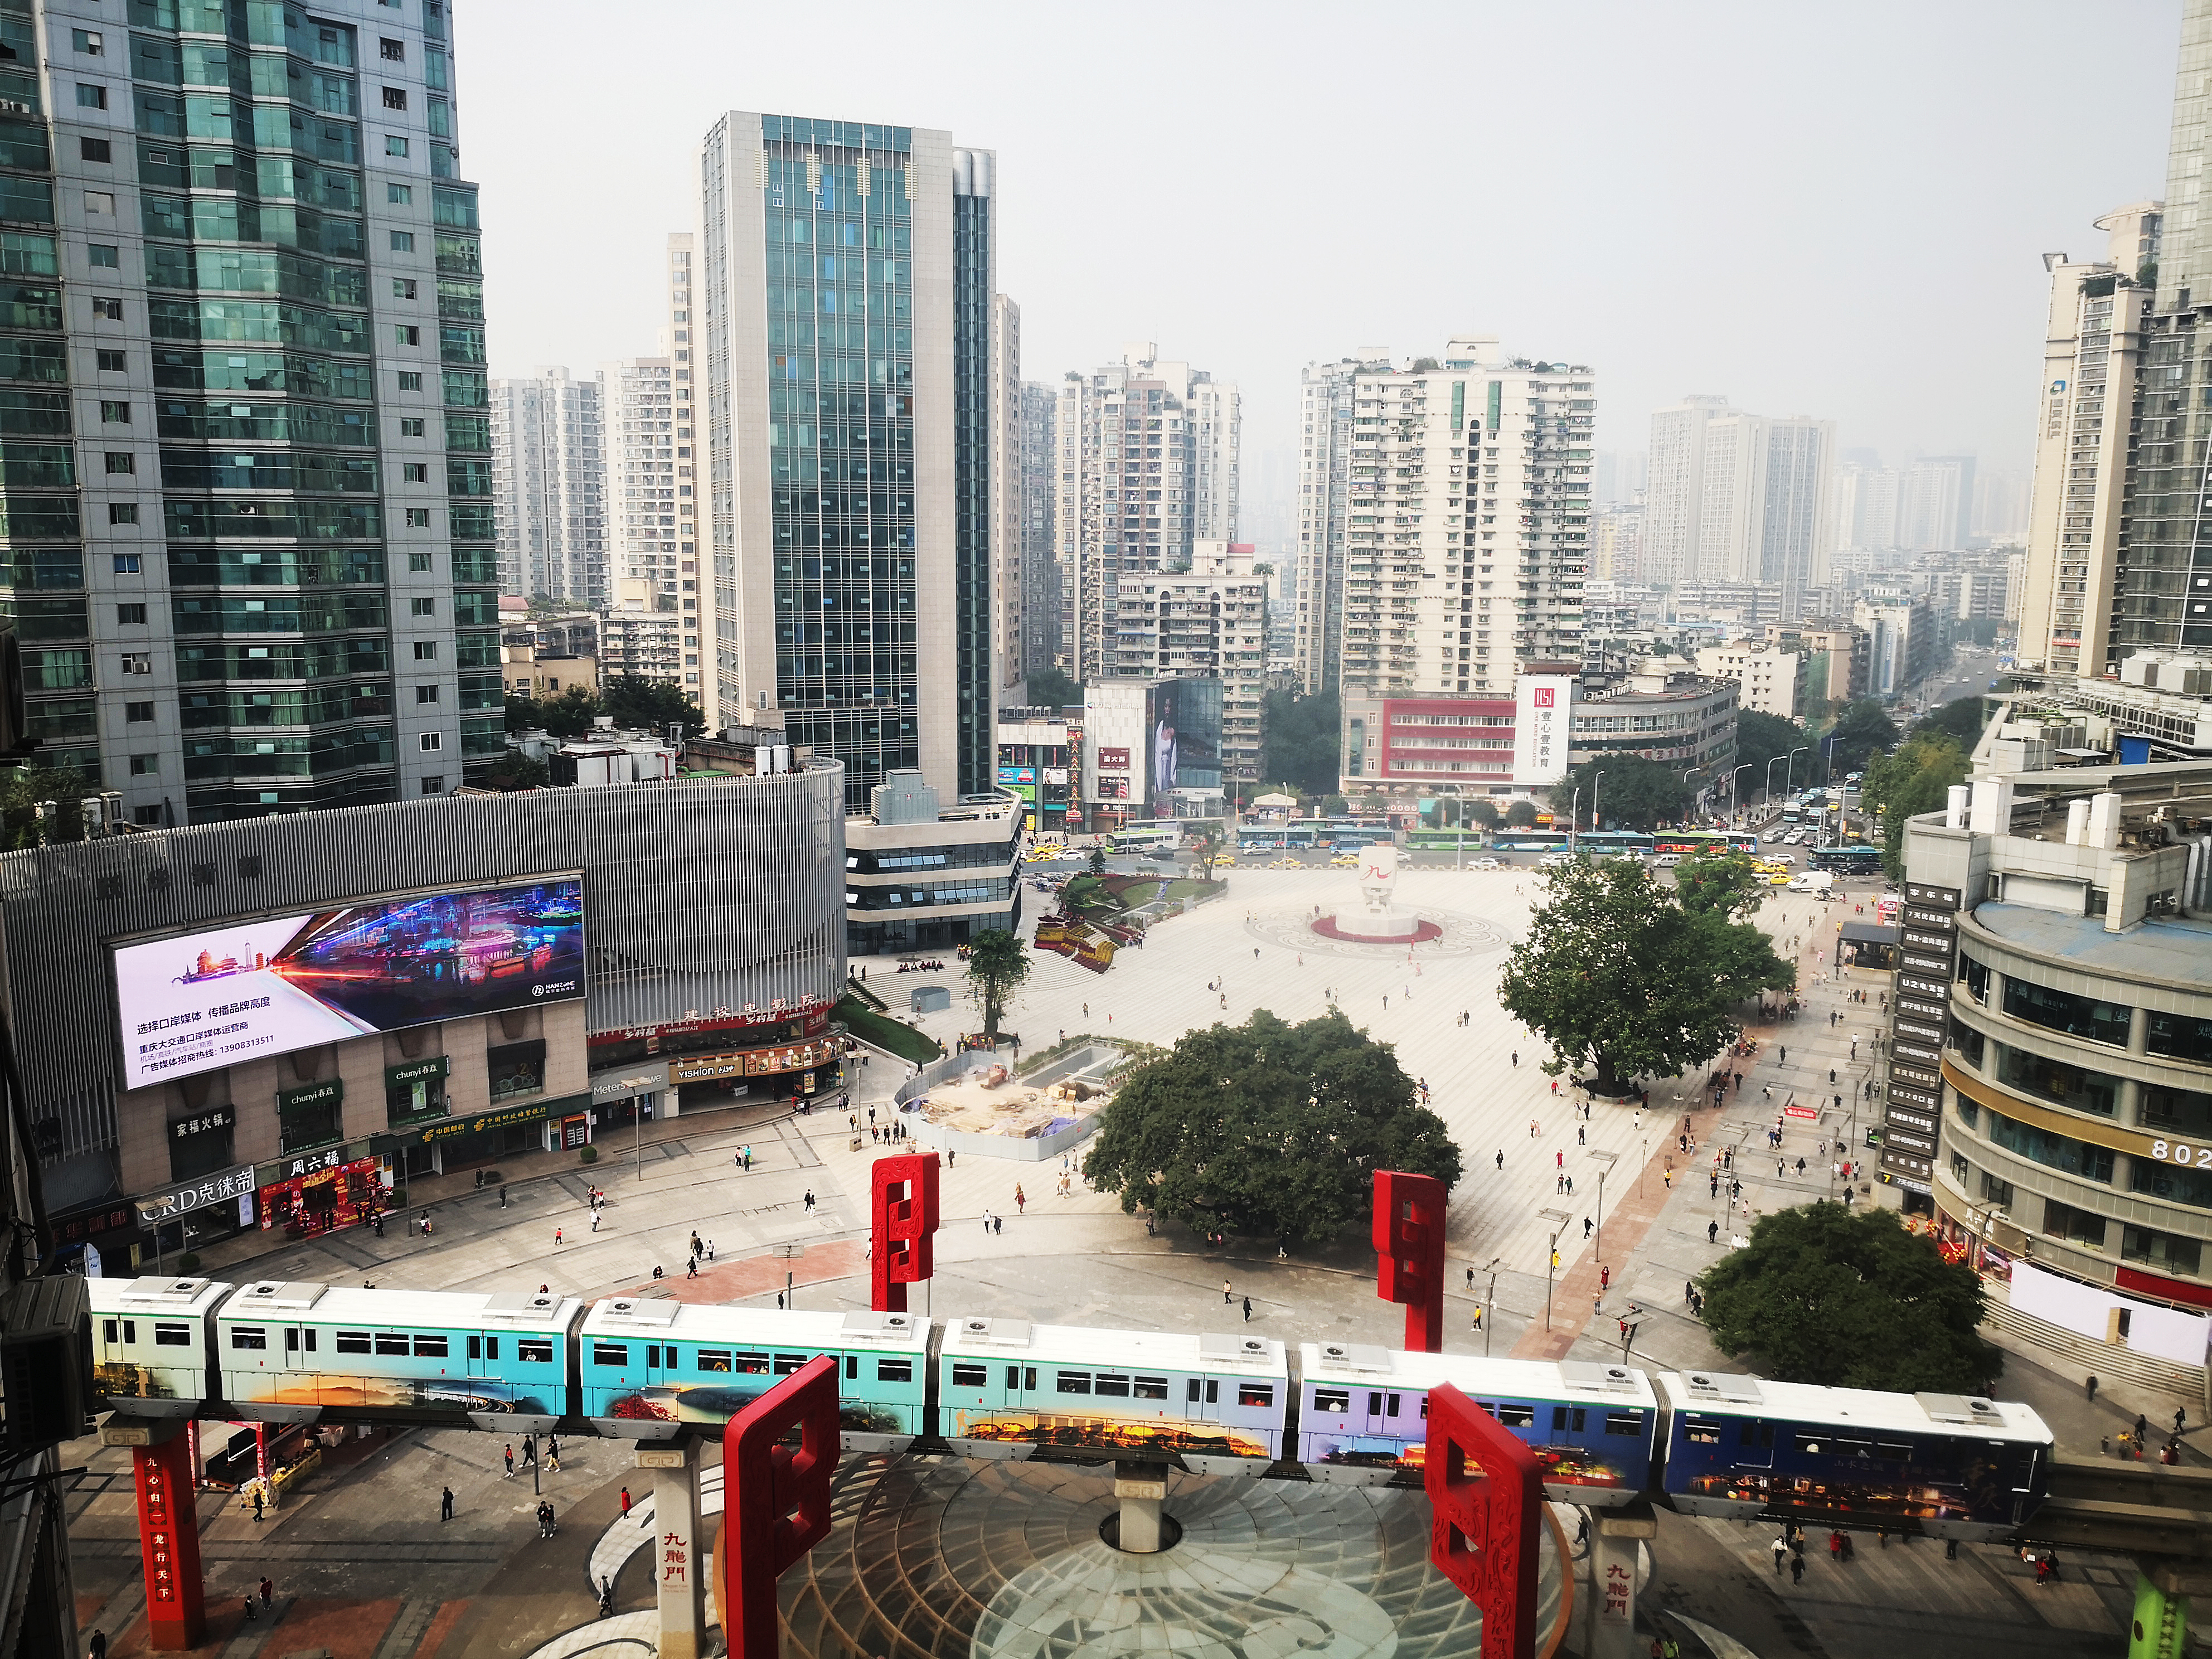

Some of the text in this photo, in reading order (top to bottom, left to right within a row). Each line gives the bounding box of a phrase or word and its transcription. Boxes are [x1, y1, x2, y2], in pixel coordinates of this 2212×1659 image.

[1540, 711, 1551, 768] 壹心壹教育
[1910, 889, 1953, 902] 家乐福
[137, 996, 270, 1035] 选择口岸媒体 传播品牌高度
[683, 993, 816, 1021] 建设电影院
[745, 1013, 776, 1025] 乡村基
[139, 1021, 249, 1054] 重庆大交通口岸媒体运营商
[220, 1035, 274, 1053] 13908313511
[624, 1027, 656, 1039] 乡村基
[177, 1113, 223, 1137] 家福火锅
[487, 1106, 546, 1124] 中国邮政储蓄银行
[436, 1124, 464, 1134] 中国邮政
[291, 1150, 339, 1176] 周六福
[2152, 1140, 2212, 1169] 802
[1883, 1174, 1890, 1183] 7
[147, 1457, 161, 1519] 九心归一
[154, 1534, 168, 1598] 龙行天下
